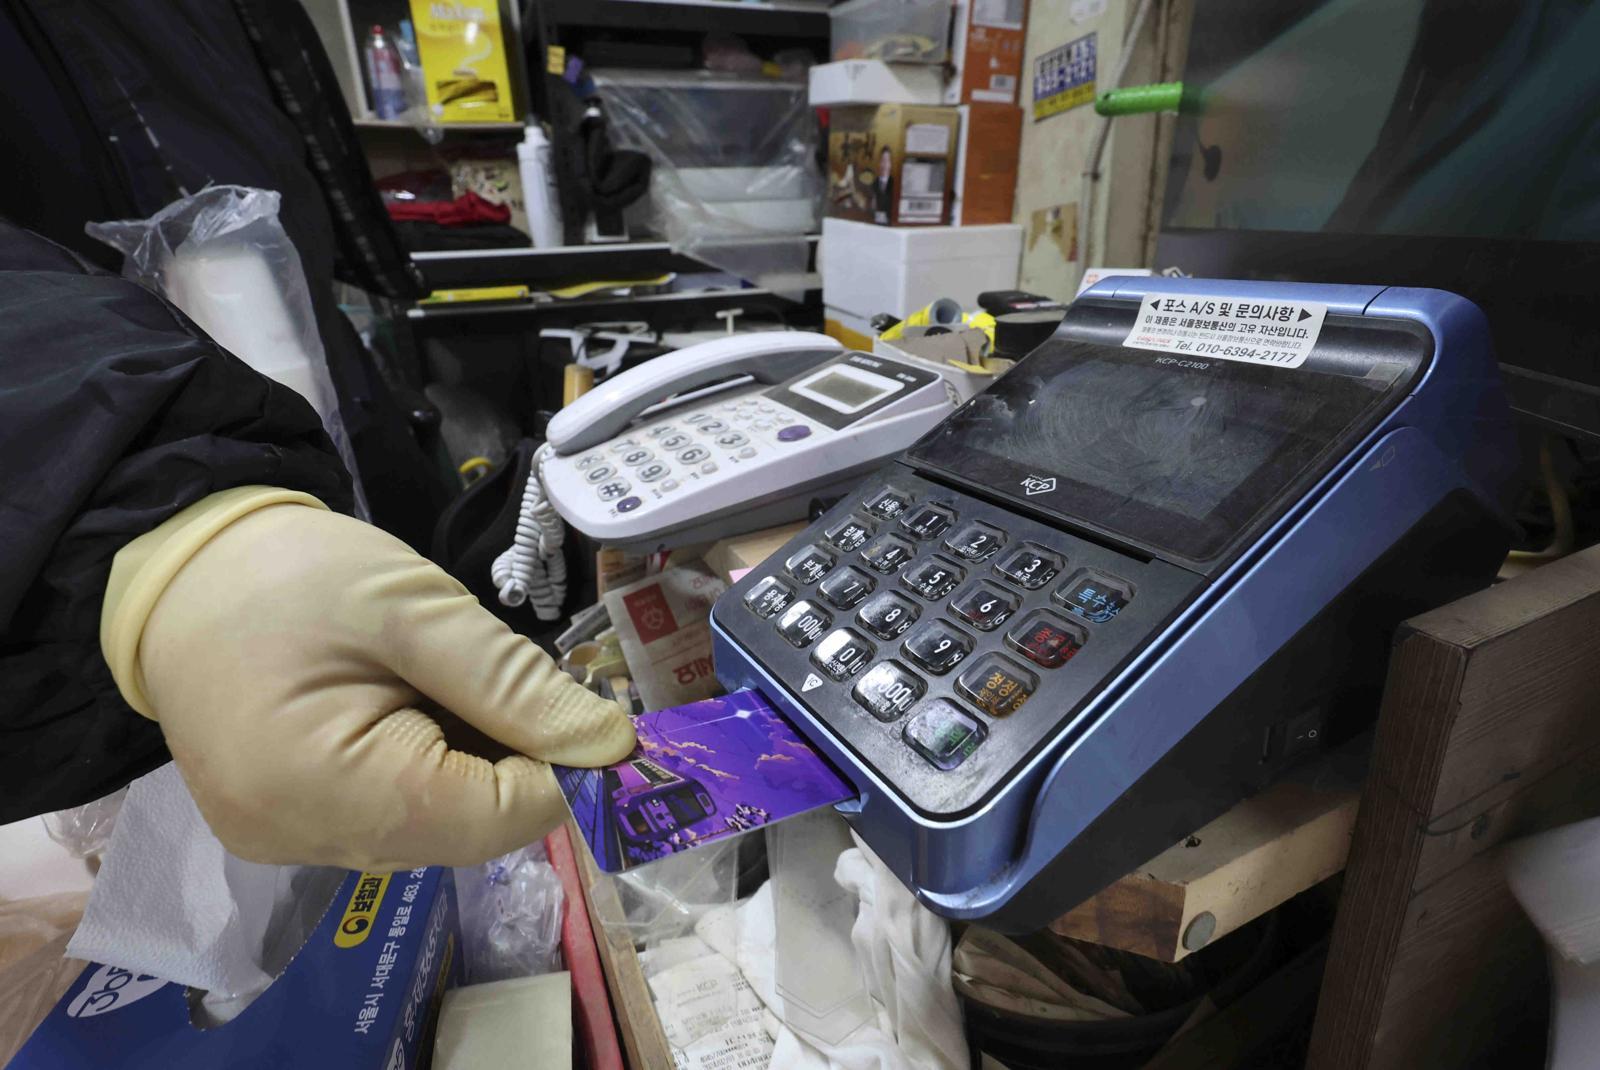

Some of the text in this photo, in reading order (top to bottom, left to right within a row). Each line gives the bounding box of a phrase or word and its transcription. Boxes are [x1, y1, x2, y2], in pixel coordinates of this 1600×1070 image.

[1163, 299, 1294, 321] 포스 A/S 및 문의사항
[1145, 315, 1308, 338] 이 제품은 서울정보통신의 고유 자산입니다.
[1175, 340, 1297, 363] Tel. 010-6394-2177
[626, 450, 647, 462] 8
[1020, 477, 1053, 492] KCP
[878, 499, 901, 512] 신용
[1025, 559, 1041, 573] 3
[929, 571, 945, 584] 5
[980, 599, 997, 612] 6
[885, 608, 901, 622] 8
[799, 615, 818, 631] 00
[934, 640, 951, 653] 9
[840, 647, 855, 661] 0
[987, 672, 1016, 696] 정정
[355, 993, 384, 1034] 서울시
[371, 941, 400, 988] 서대문구
[389, 906, 412, 937] 통일로
[402, 882, 422, 903] 463,
